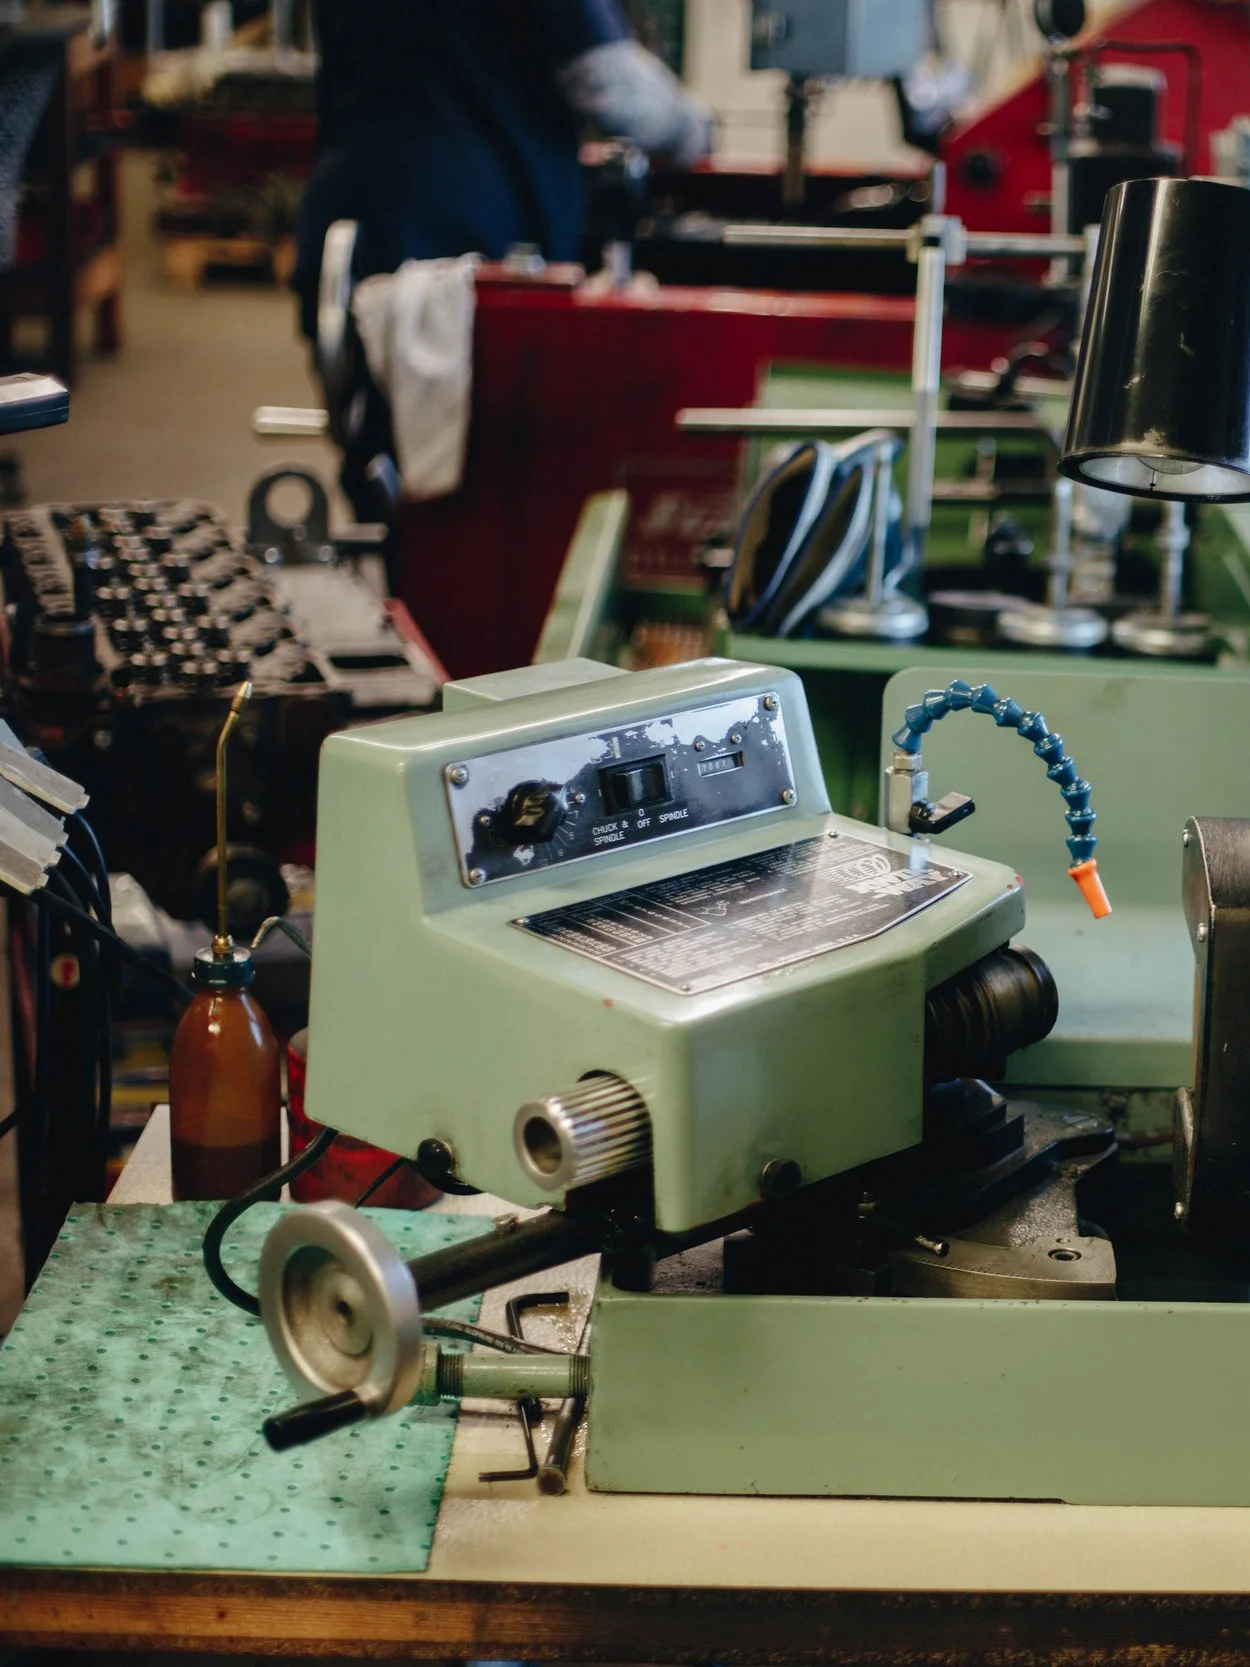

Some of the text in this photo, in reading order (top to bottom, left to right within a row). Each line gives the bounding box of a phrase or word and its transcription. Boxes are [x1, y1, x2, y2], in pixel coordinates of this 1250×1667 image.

[573, 810, 579, 819] 7
[592, 808, 689, 836] CHUCK & OFF SPINDLE
[568, 831, 575, 840] 8
[593, 831, 626, 846] SPINDLE
[557, 848, 564, 857] 9
